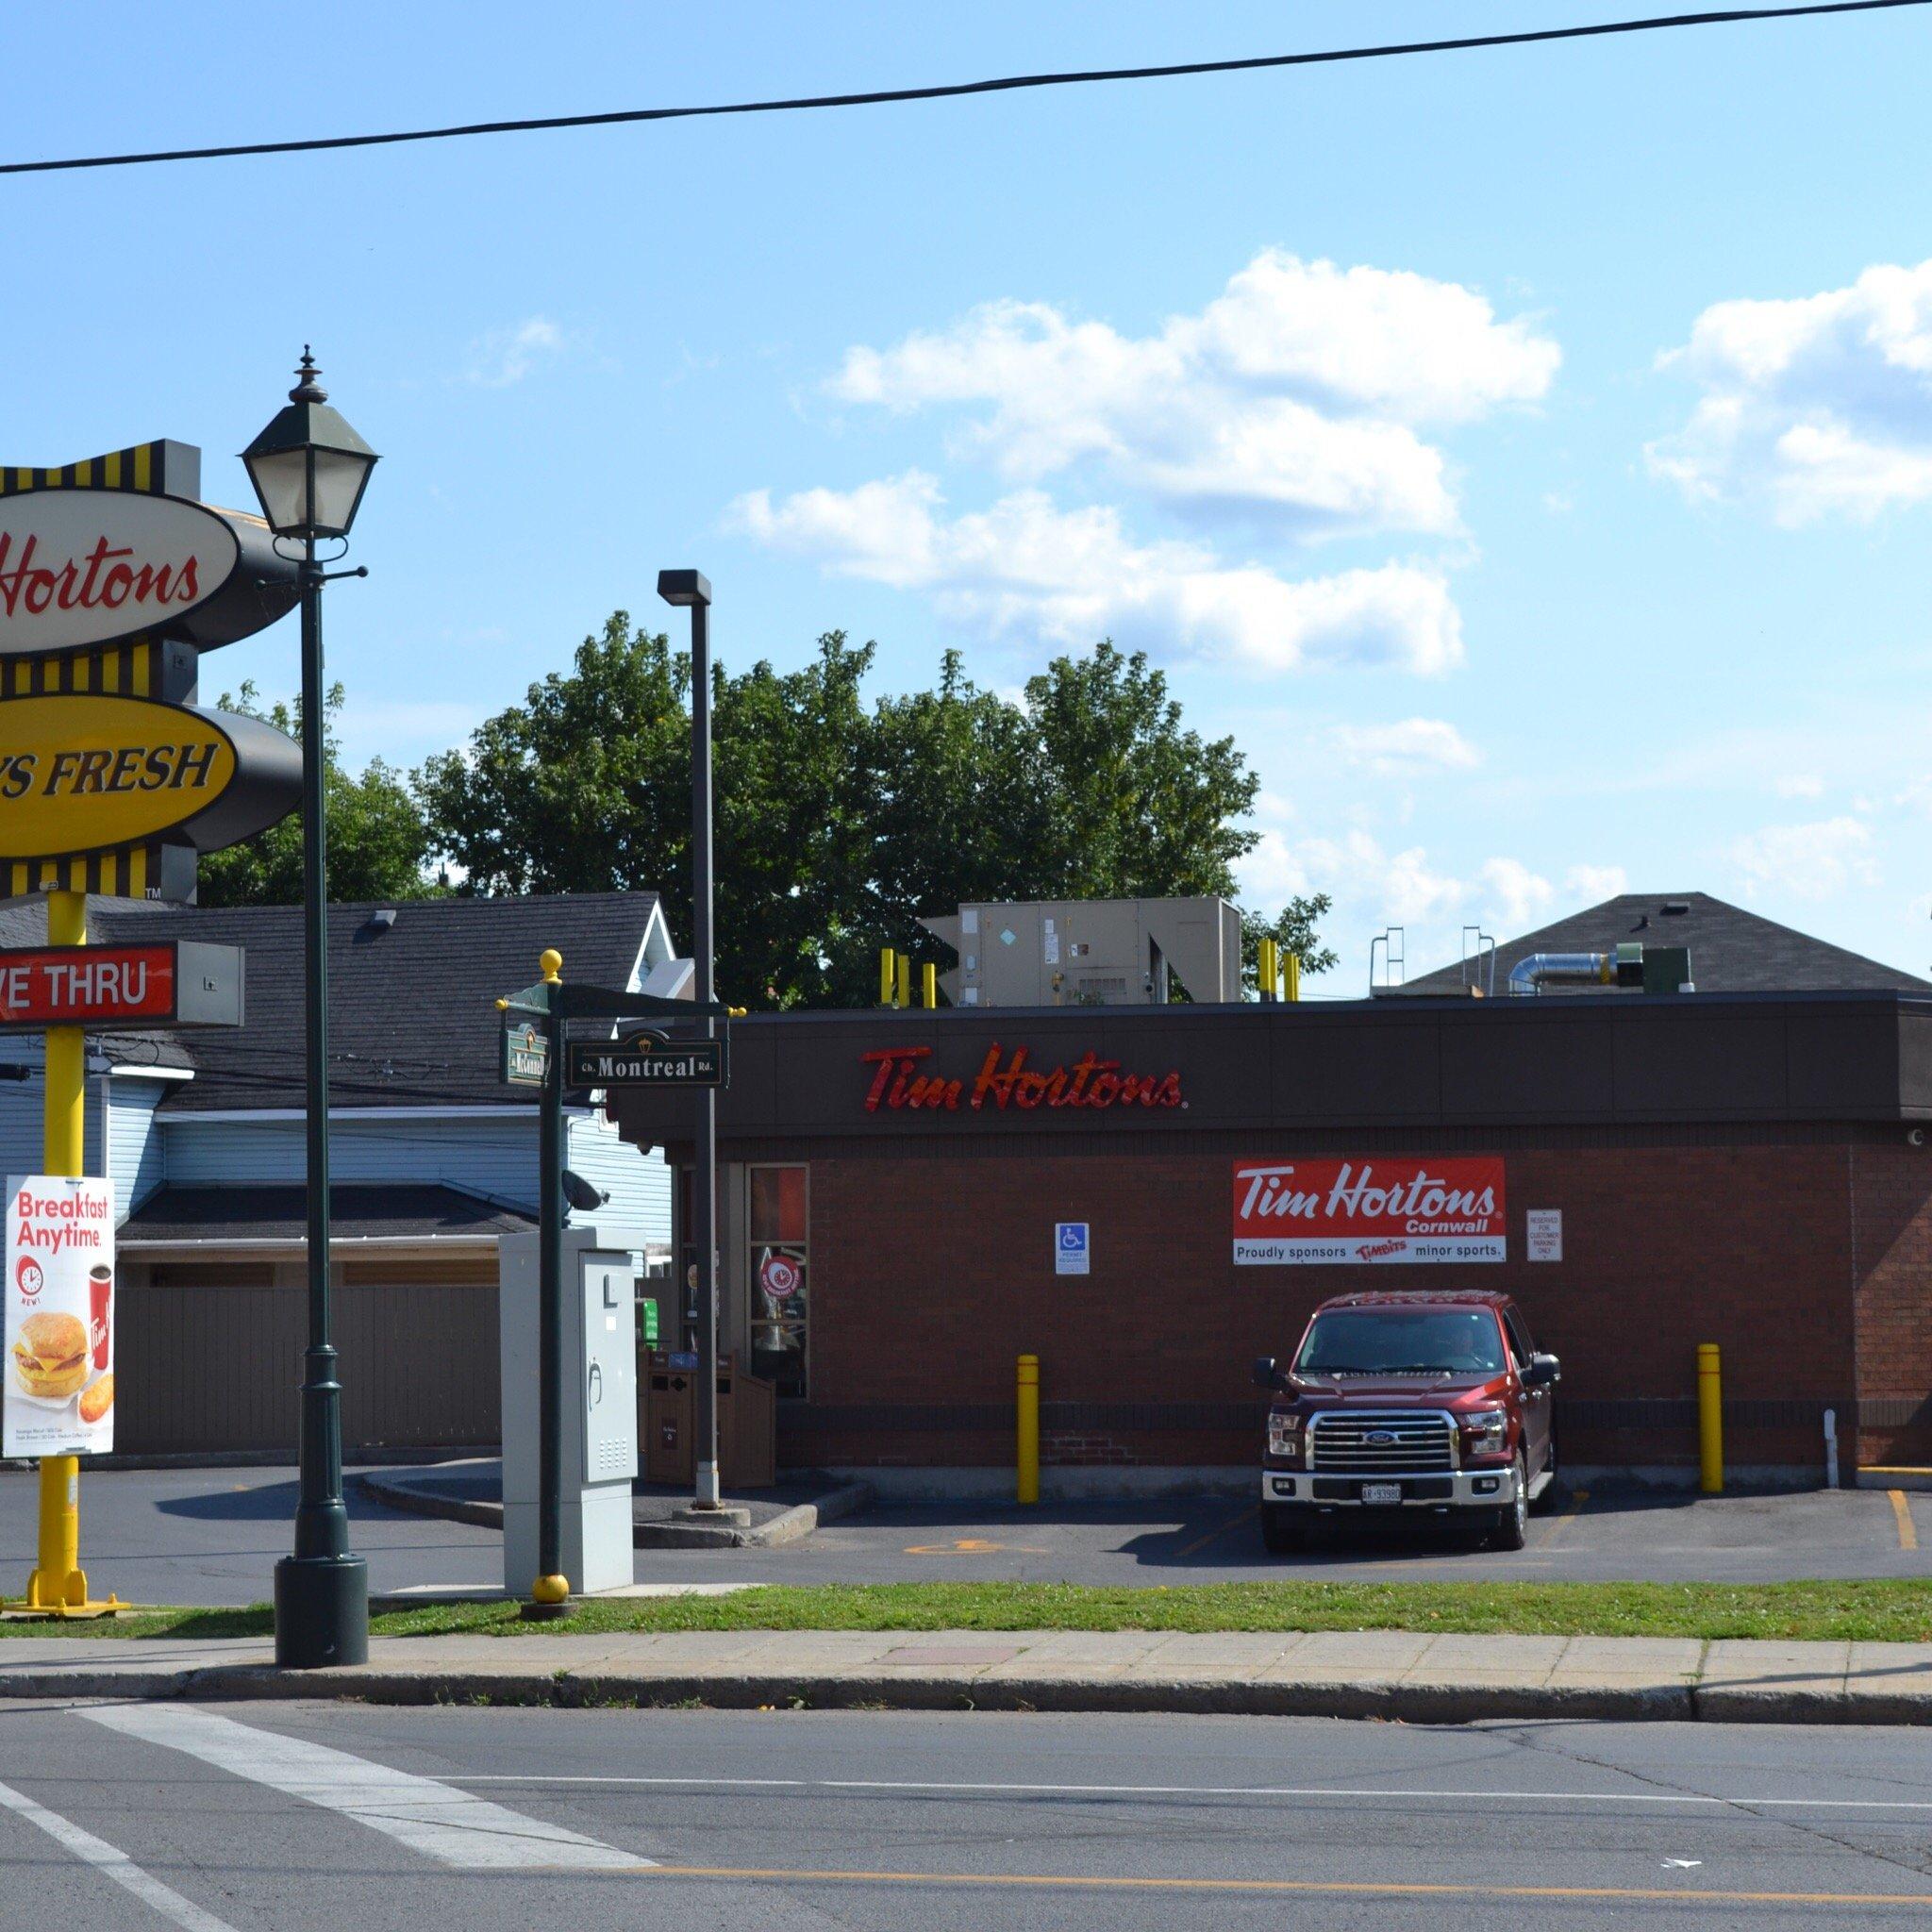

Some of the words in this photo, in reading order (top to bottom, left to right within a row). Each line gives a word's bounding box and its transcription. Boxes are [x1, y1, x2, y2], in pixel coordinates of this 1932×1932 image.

[42, 742, 222, 797] FRESH
[144, 887, 161, 900] TM
[44, 960, 146, 1008] THRU
[597, 1056, 696, 1077] Montreal
[698, 1061, 713, 1072] Rd.
[859, 1046, 962, 1112] Tim
[970, 1041, 1181, 1111] Hortons
[17, 1191, 108, 1220] Breakfast
[1236, 1165, 1320, 1220] Tim
[1324, 1162, 1496, 1218] Hortons
[16, 1220, 102, 1256] Anytime.
[1405, 1218, 1489, 1234] Cornwall
[1237, 1245, 1285, 1259] Proudly
[1289, 1247, 1346, 1260] sponsors
[1415, 1244, 1453, 1257] minor
[1457, 1243, 1501, 1259] sports.
